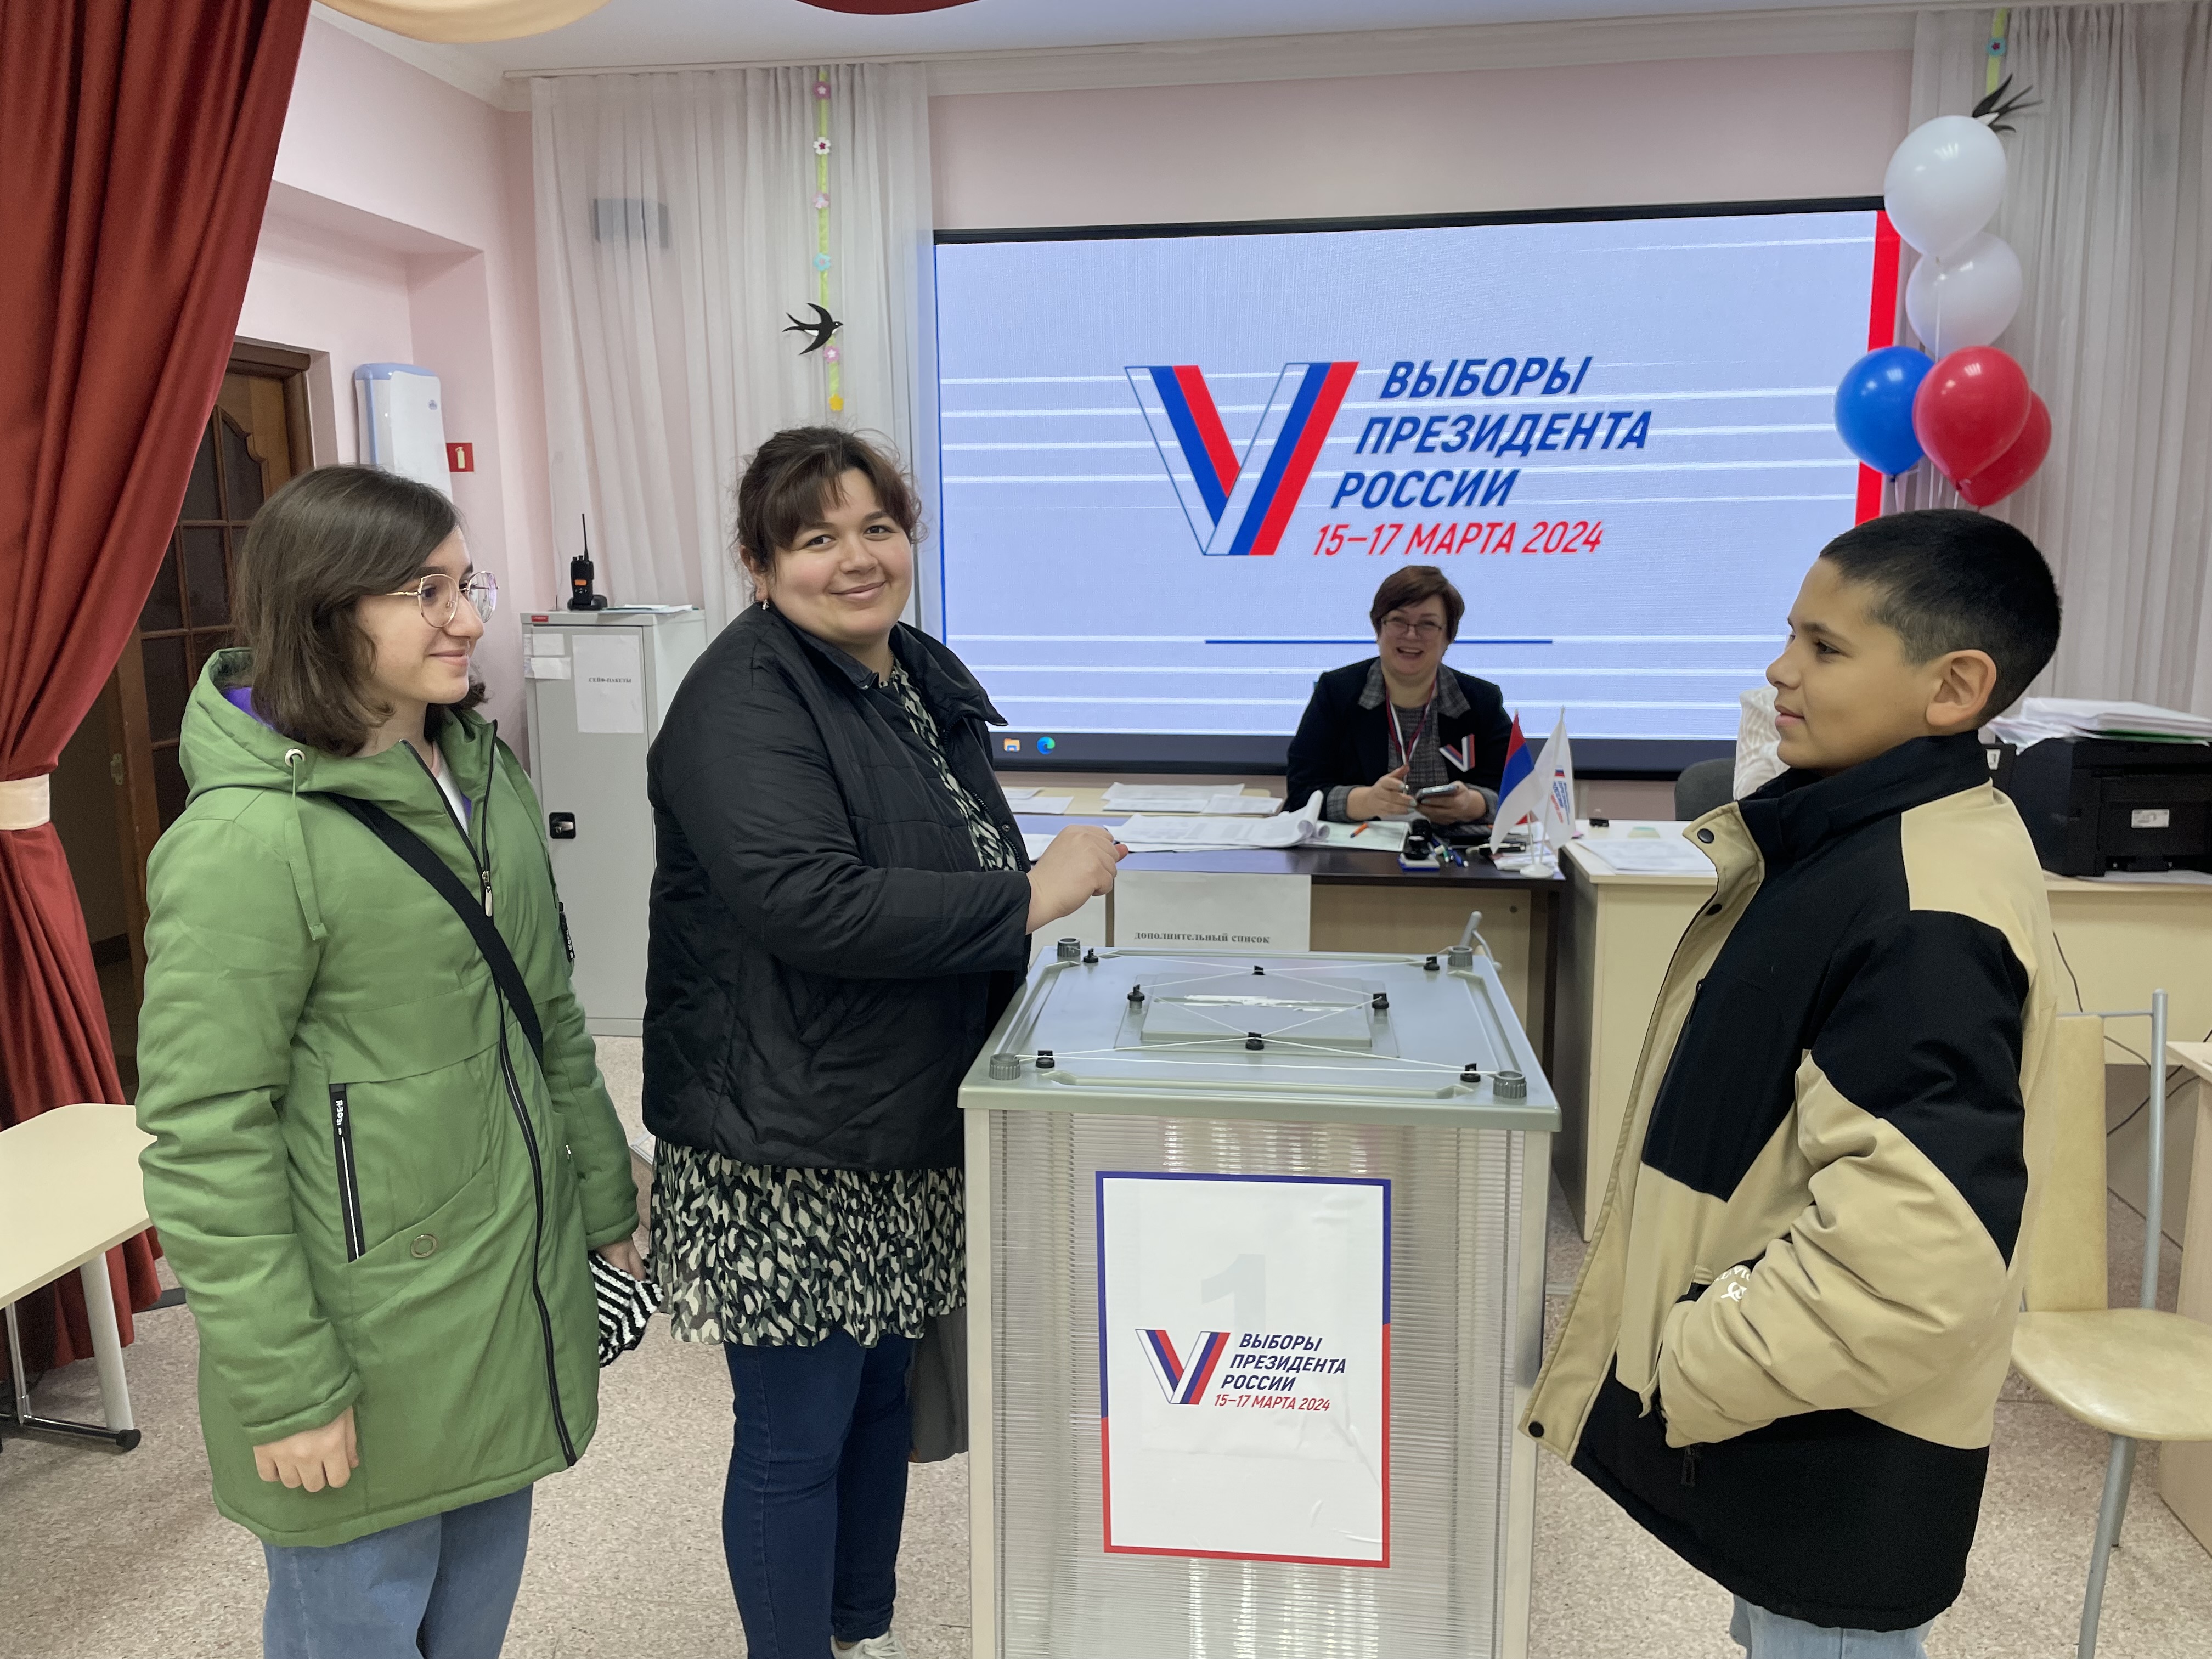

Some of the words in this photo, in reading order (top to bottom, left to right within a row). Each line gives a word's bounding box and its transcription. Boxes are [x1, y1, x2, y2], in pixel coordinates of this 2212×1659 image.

[1379, 357, 1593, 399] ВЫБОРЫ
[1355, 411, 1651, 458] ПРЕЗИДЕНТА
[1331, 469, 1521, 509] РОССИИ
[1404, 521, 1516, 555] МАРТА
[1521, 521, 1603, 554] 2024
[1239, 1333, 1323, 1351] ВЫБОРЫ
[1229, 1353, 1346, 1374] ПРЕЗИДЕНТА
[1221, 1375, 1296, 1391] РОССИИ
[1251, 1396, 1295, 1410] МАРТА
[1298, 1397, 1330, 1411] 2024
